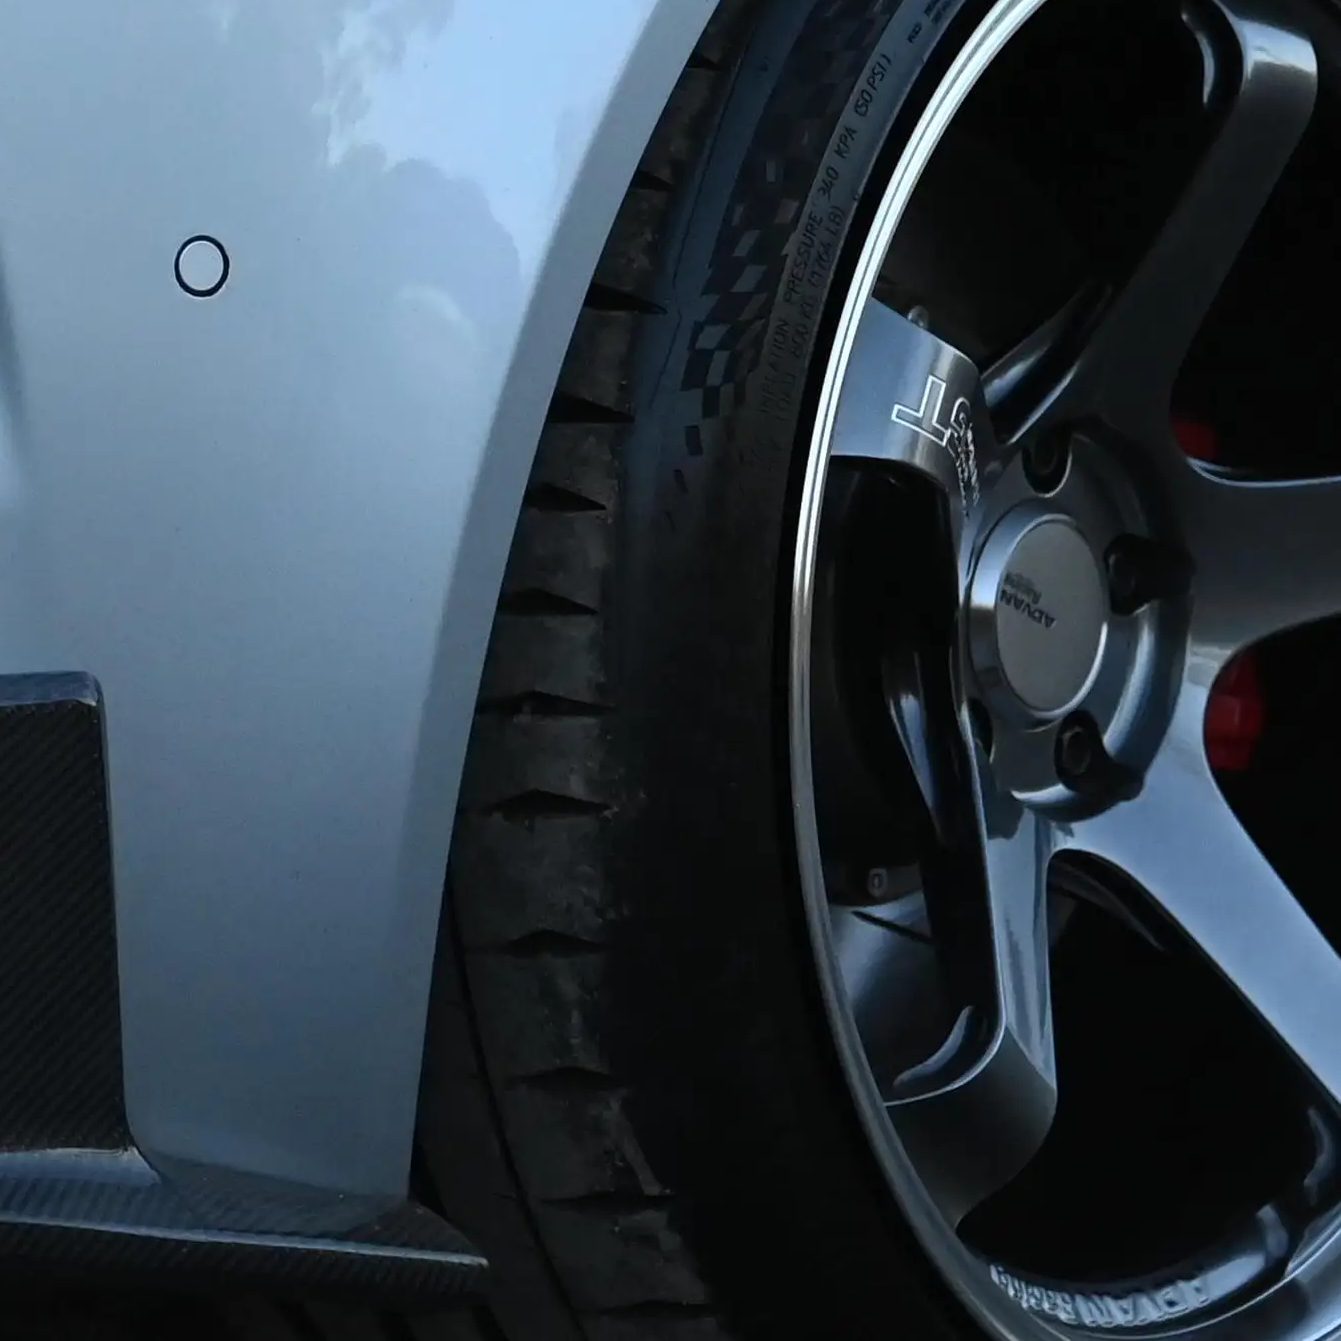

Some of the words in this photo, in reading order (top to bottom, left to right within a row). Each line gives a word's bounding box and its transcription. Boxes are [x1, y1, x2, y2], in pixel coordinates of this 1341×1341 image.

[783, 210, 824, 305] PRESSURE
[817, 166, 840, 202] 340
[834, 124, 858, 160] KPA
[999, 588, 1056, 629] ADVAN
